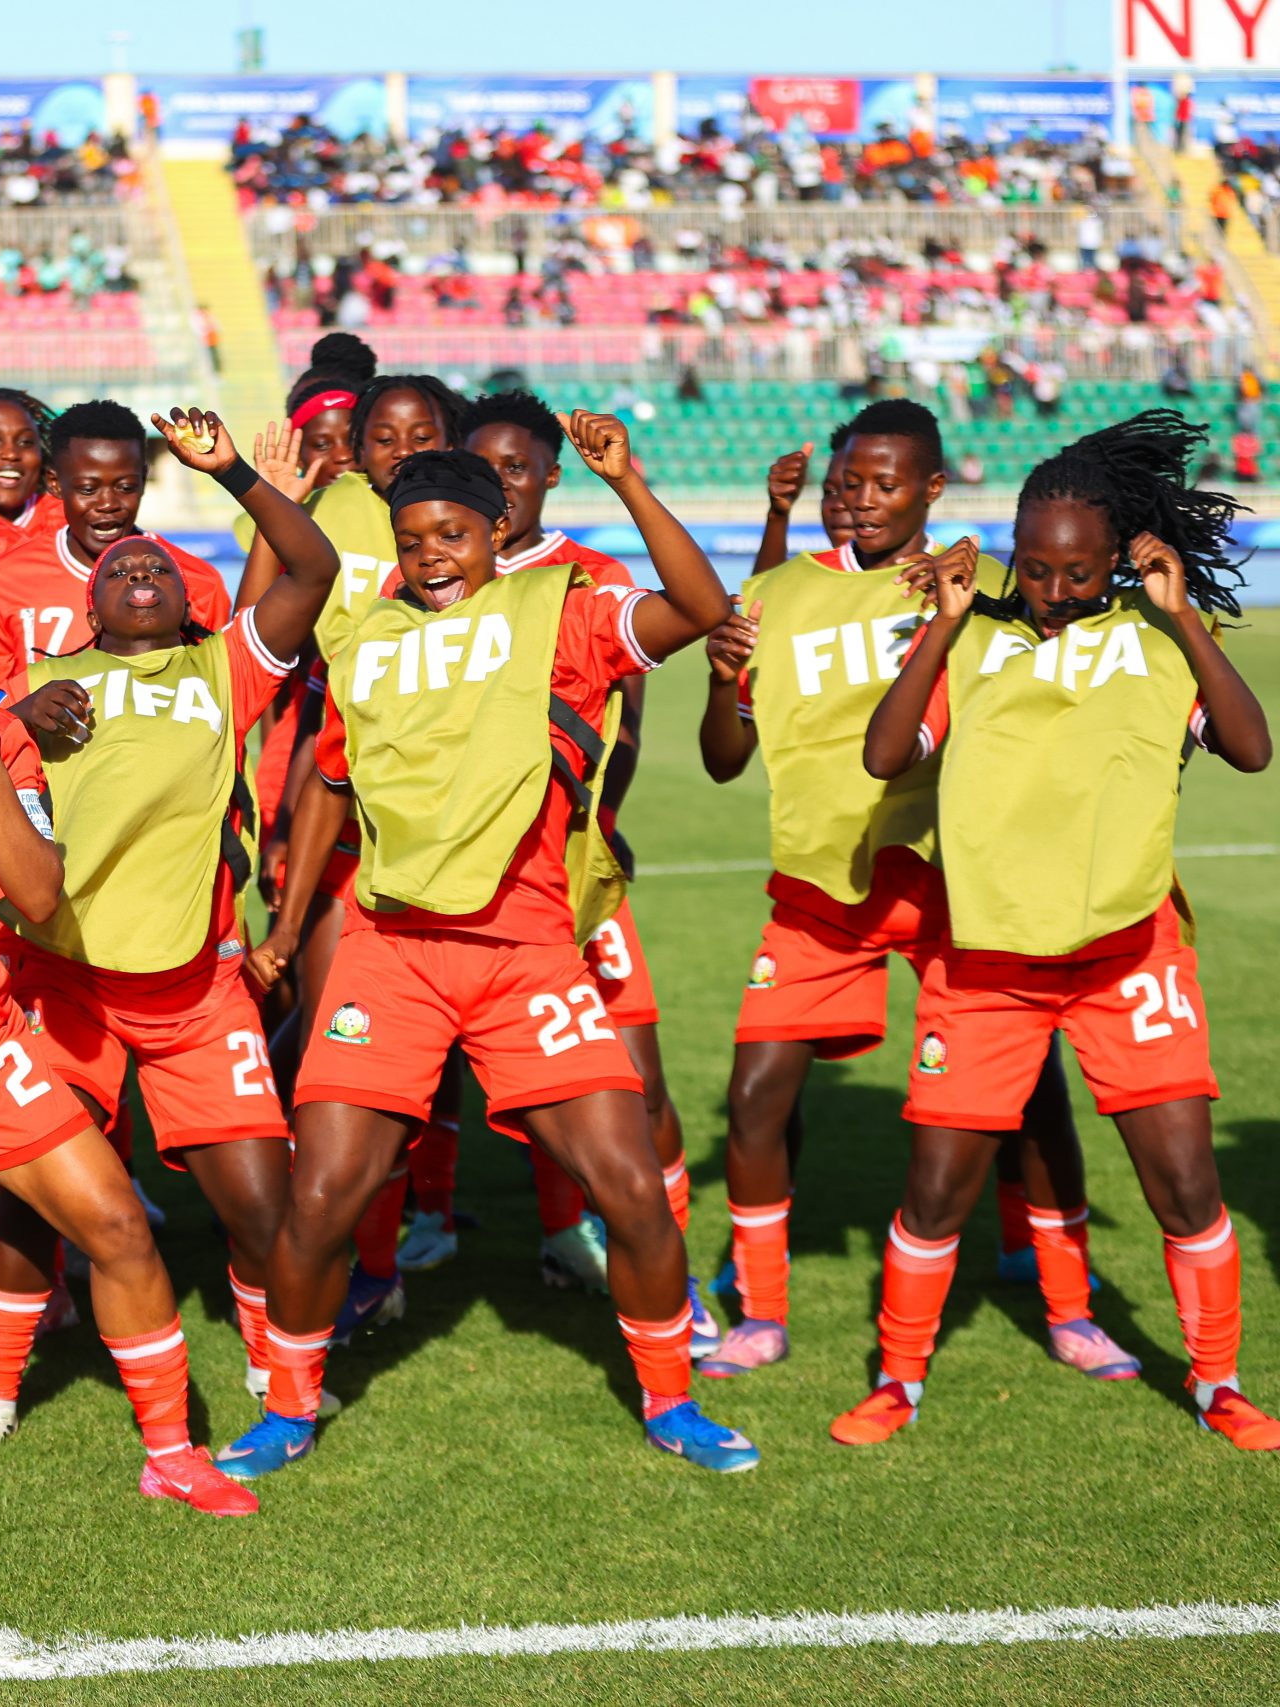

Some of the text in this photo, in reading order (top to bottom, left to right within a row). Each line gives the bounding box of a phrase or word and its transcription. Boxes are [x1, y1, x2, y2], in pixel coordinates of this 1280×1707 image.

[20, 607, 74, 664] 17
[352, 613, 512, 703] FIFA
[978, 622, 1149, 692] FIFA
[528, 984, 616, 1057] 22
[1120, 964, 1198, 1042] 24
